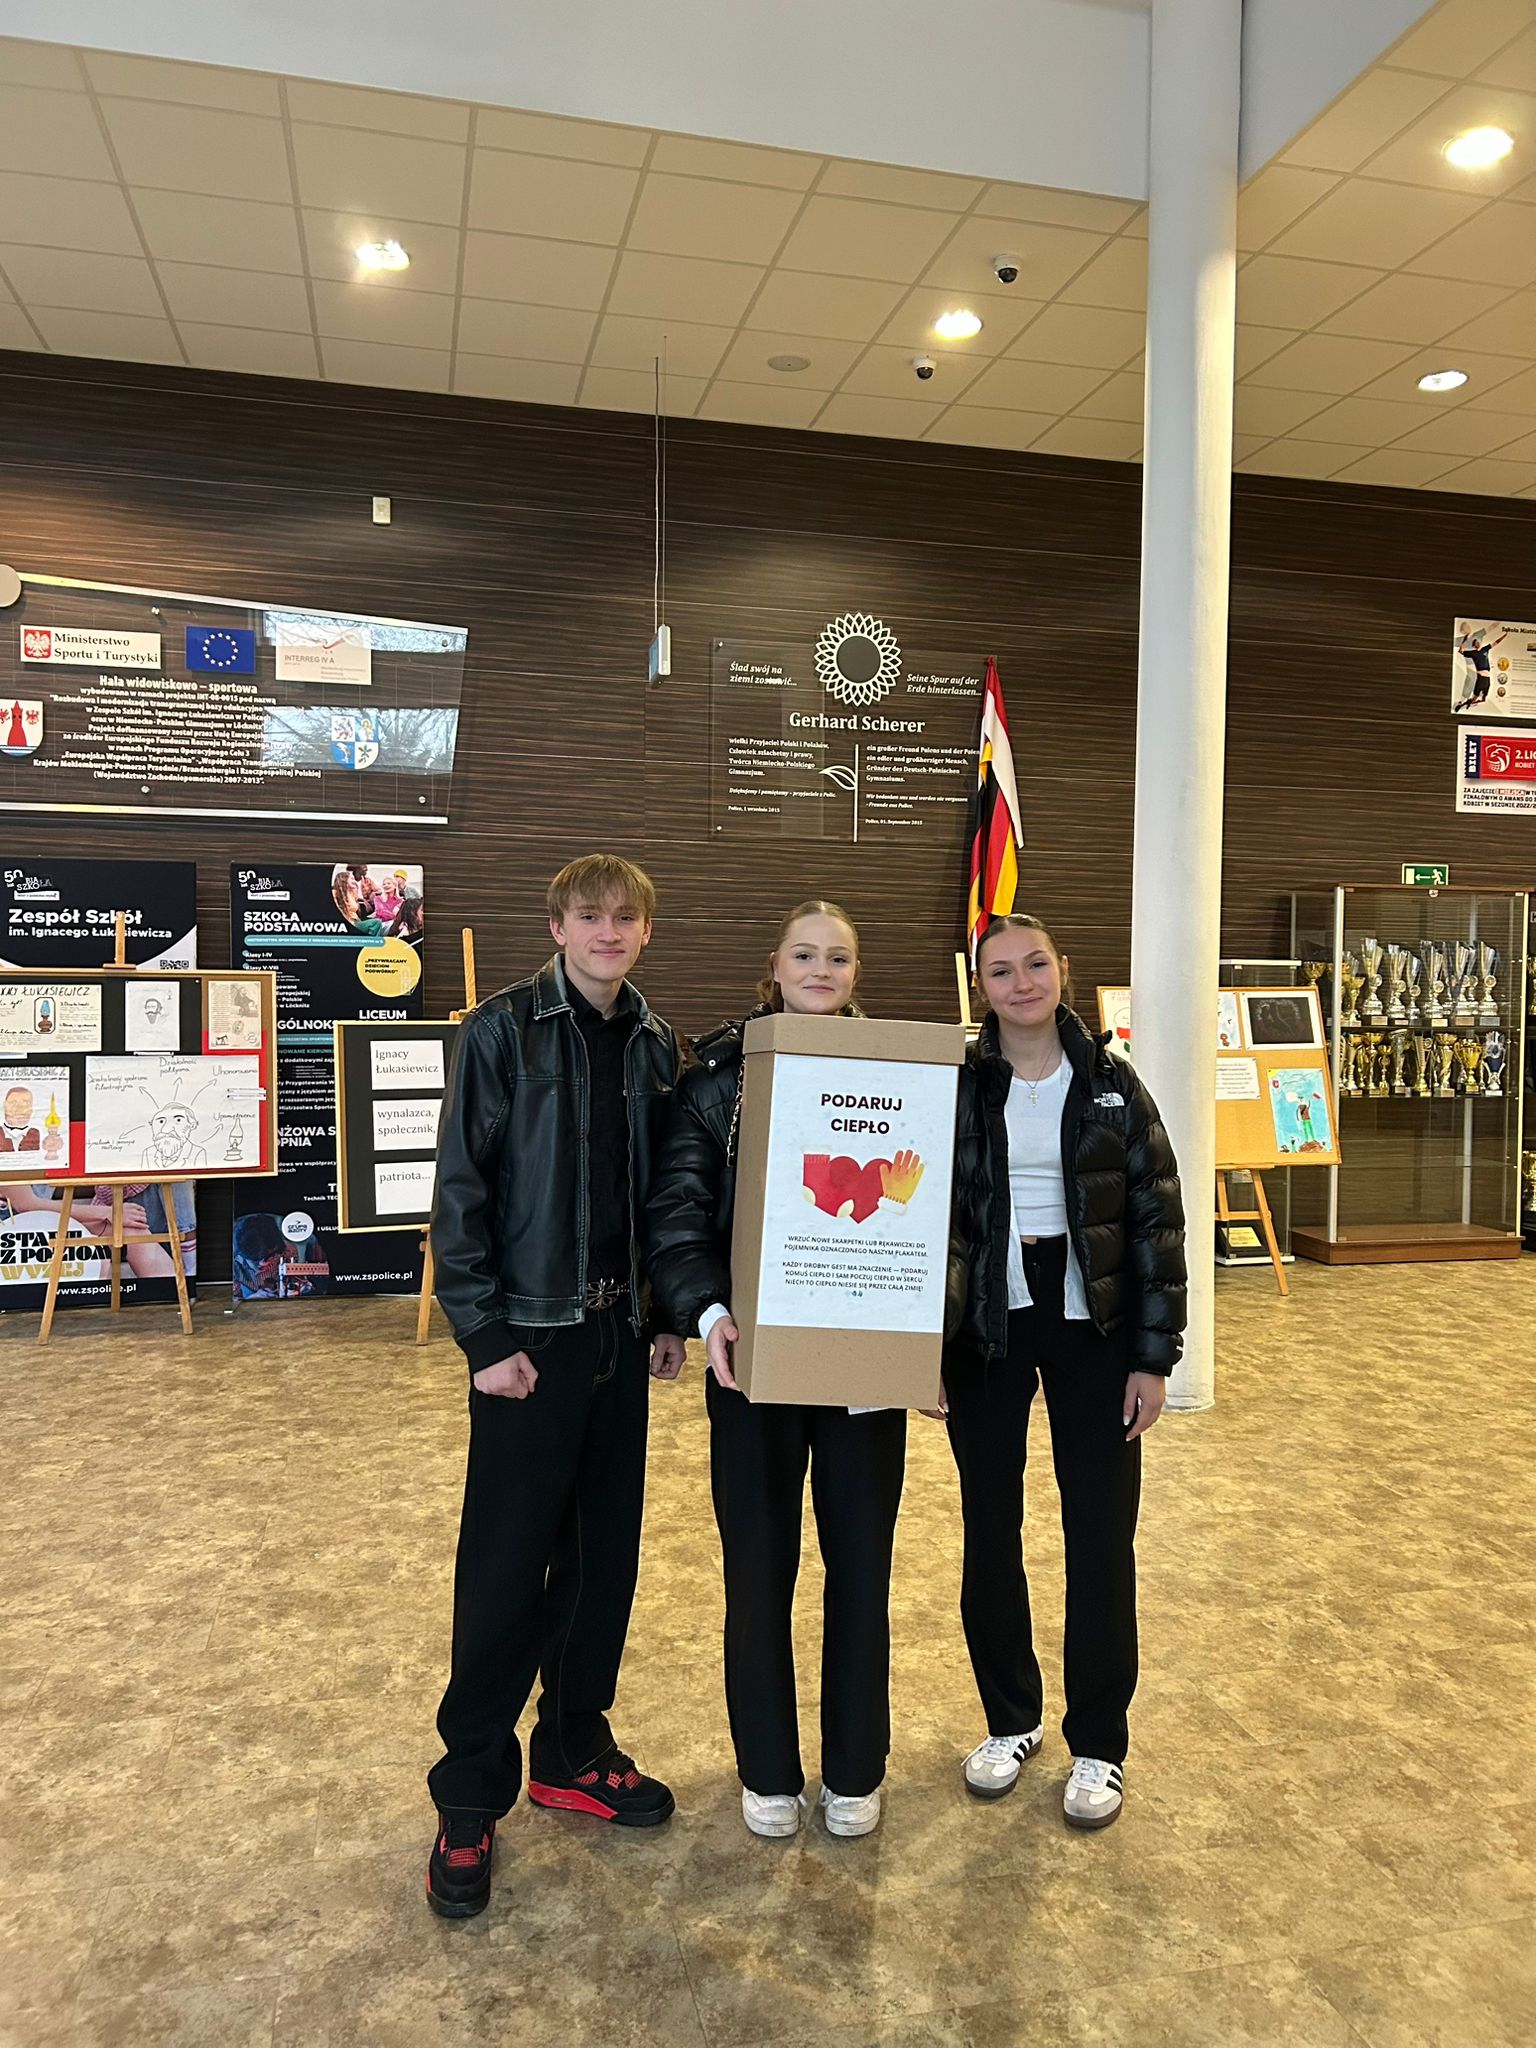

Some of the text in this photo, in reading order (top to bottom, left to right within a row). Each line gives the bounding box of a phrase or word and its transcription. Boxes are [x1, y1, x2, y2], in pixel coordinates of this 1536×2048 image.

[54, 632, 129, 646] Ministerstwo
[54, 648, 158, 664] Sportu i Turystyki
[284, 654, 319, 662] INTERREG
[730, 661, 782, 674] Ślad swój na
[100, 674, 257, 695] Hala widowiskowo sportowa
[729, 674, 752, 683] ziemi
[907, 674, 979, 685] Seine Spur auf der
[907, 684, 981, 695] Erde hinterlassen...
[789, 712, 925, 732] Gerhard Scherer
[88, 724, 114, 733] Projekt
[1468, 740, 1477, 772] BILET
[9, 908, 80, 926] Zespół
[243, 911, 300, 921] SZKOŁA
[9, 927, 172, 938] im. Ignacego Łuksiewicza
[244, 922, 348, 932] PODSTAWOWA
[359, 1010, 407, 1019] LICEUM
[375, 1049, 408, 1060] Ignacy
[375, 1063, 438, 1073] Łukasiewicz
[821, 1093, 902, 1111] PODARUJ
[377, 1108, 433, 1120] wynalazca,
[377, 1123, 436, 1136] społecznik,
[830, 1118, 889, 1134] CIEPŁO
[379, 1172, 431, 1183] patriota...
[788, 1234, 810, 1242] WRZUĆ
[878, 1241, 914, 1249] RĘKAWICZKI
[0, 1248, 16, 1264] Z
[335, 1270, 413, 1282] www.zspolice.pl
